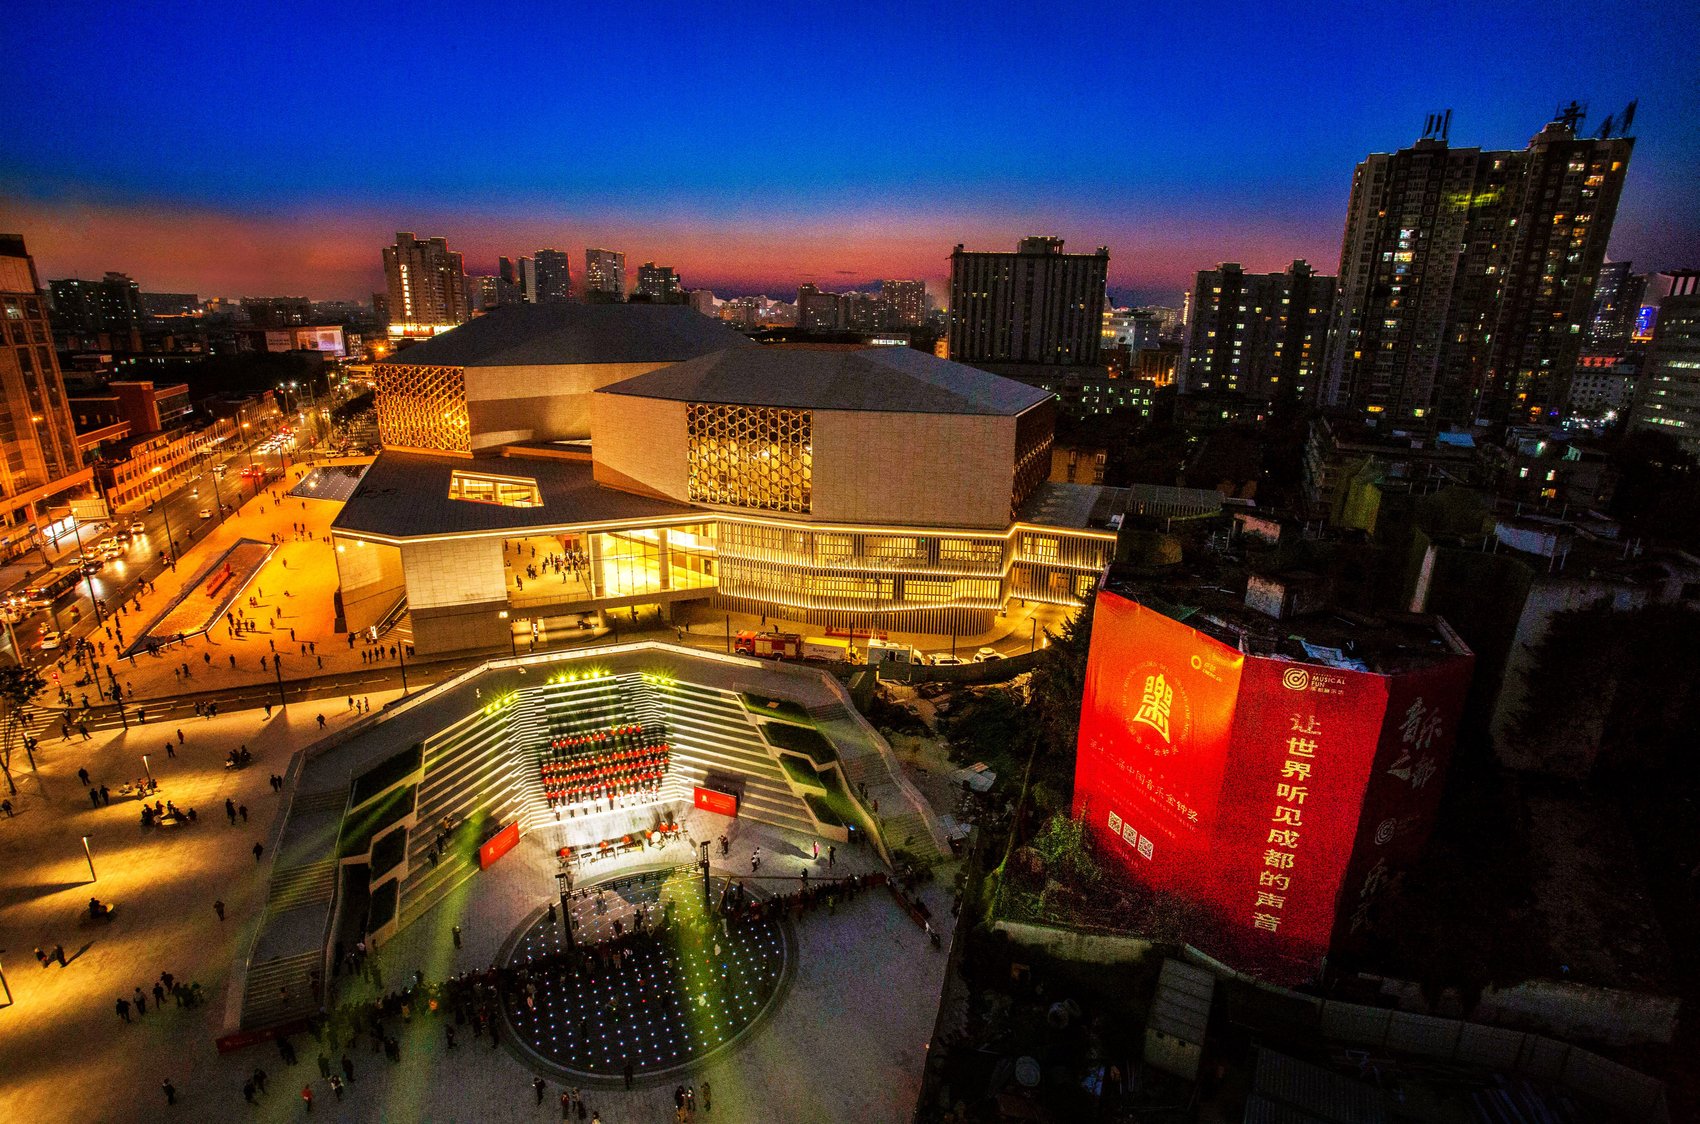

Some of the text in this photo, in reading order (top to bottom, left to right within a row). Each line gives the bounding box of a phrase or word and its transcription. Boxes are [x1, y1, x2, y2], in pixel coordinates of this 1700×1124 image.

[1311, 680, 1325, 688] FUN
[1312, 675, 1346, 685] MUSICAL
[1252, 713, 1321, 933] 让世界听见成都的声音
